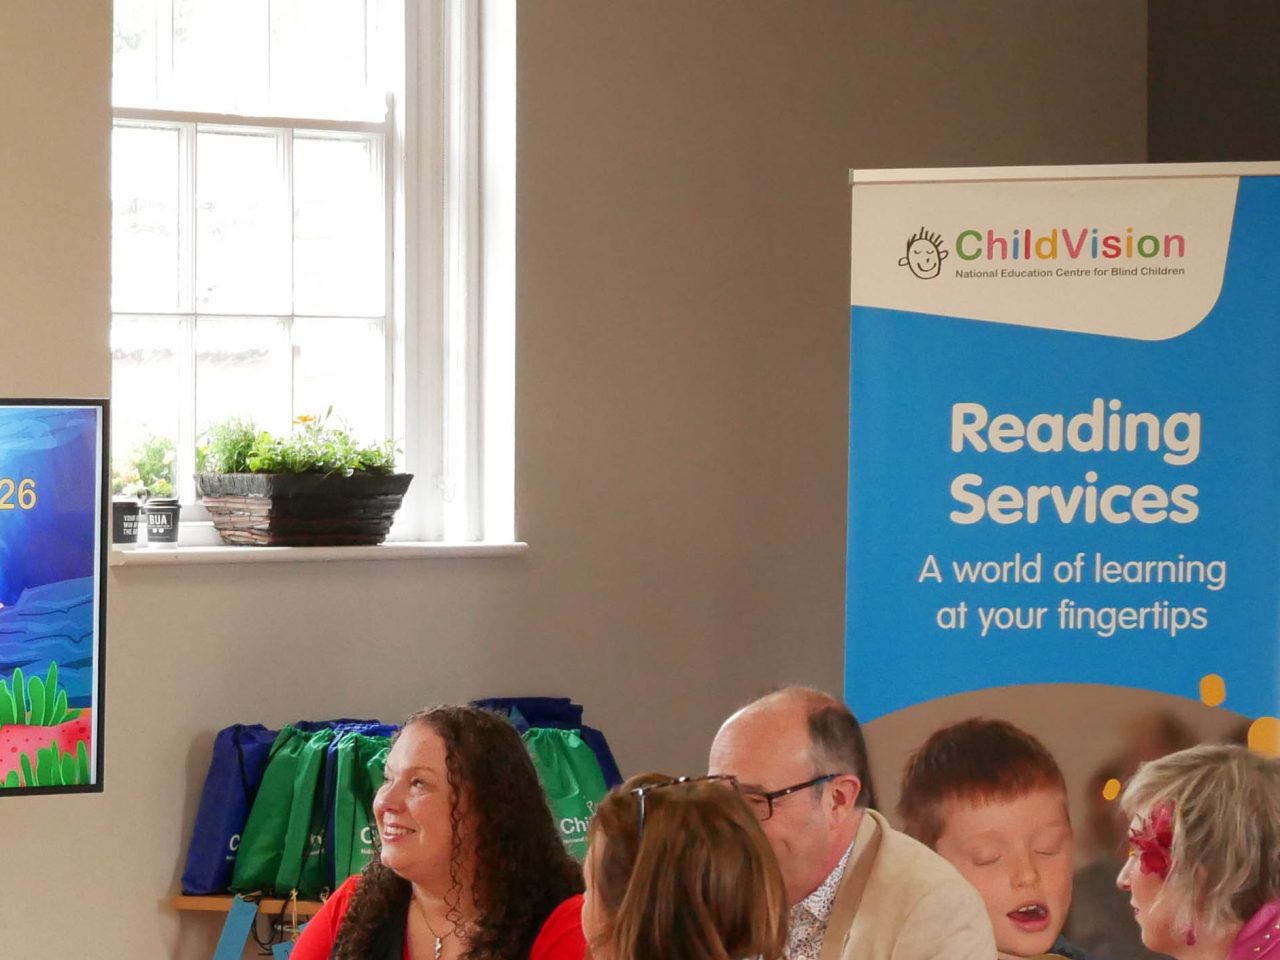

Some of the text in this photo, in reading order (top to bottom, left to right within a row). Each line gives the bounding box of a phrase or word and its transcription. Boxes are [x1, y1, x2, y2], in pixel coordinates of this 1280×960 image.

[955, 226, 1186, 261] ChildVision
[955, 266, 1186, 279] National Education Centre for Blind Children
[950, 397, 1201, 466] Reading
[949, 470, 1200, 525] Services
[918, 552, 1227, 591] A world of learning
[936, 598, 1208, 637] at your fingertips
